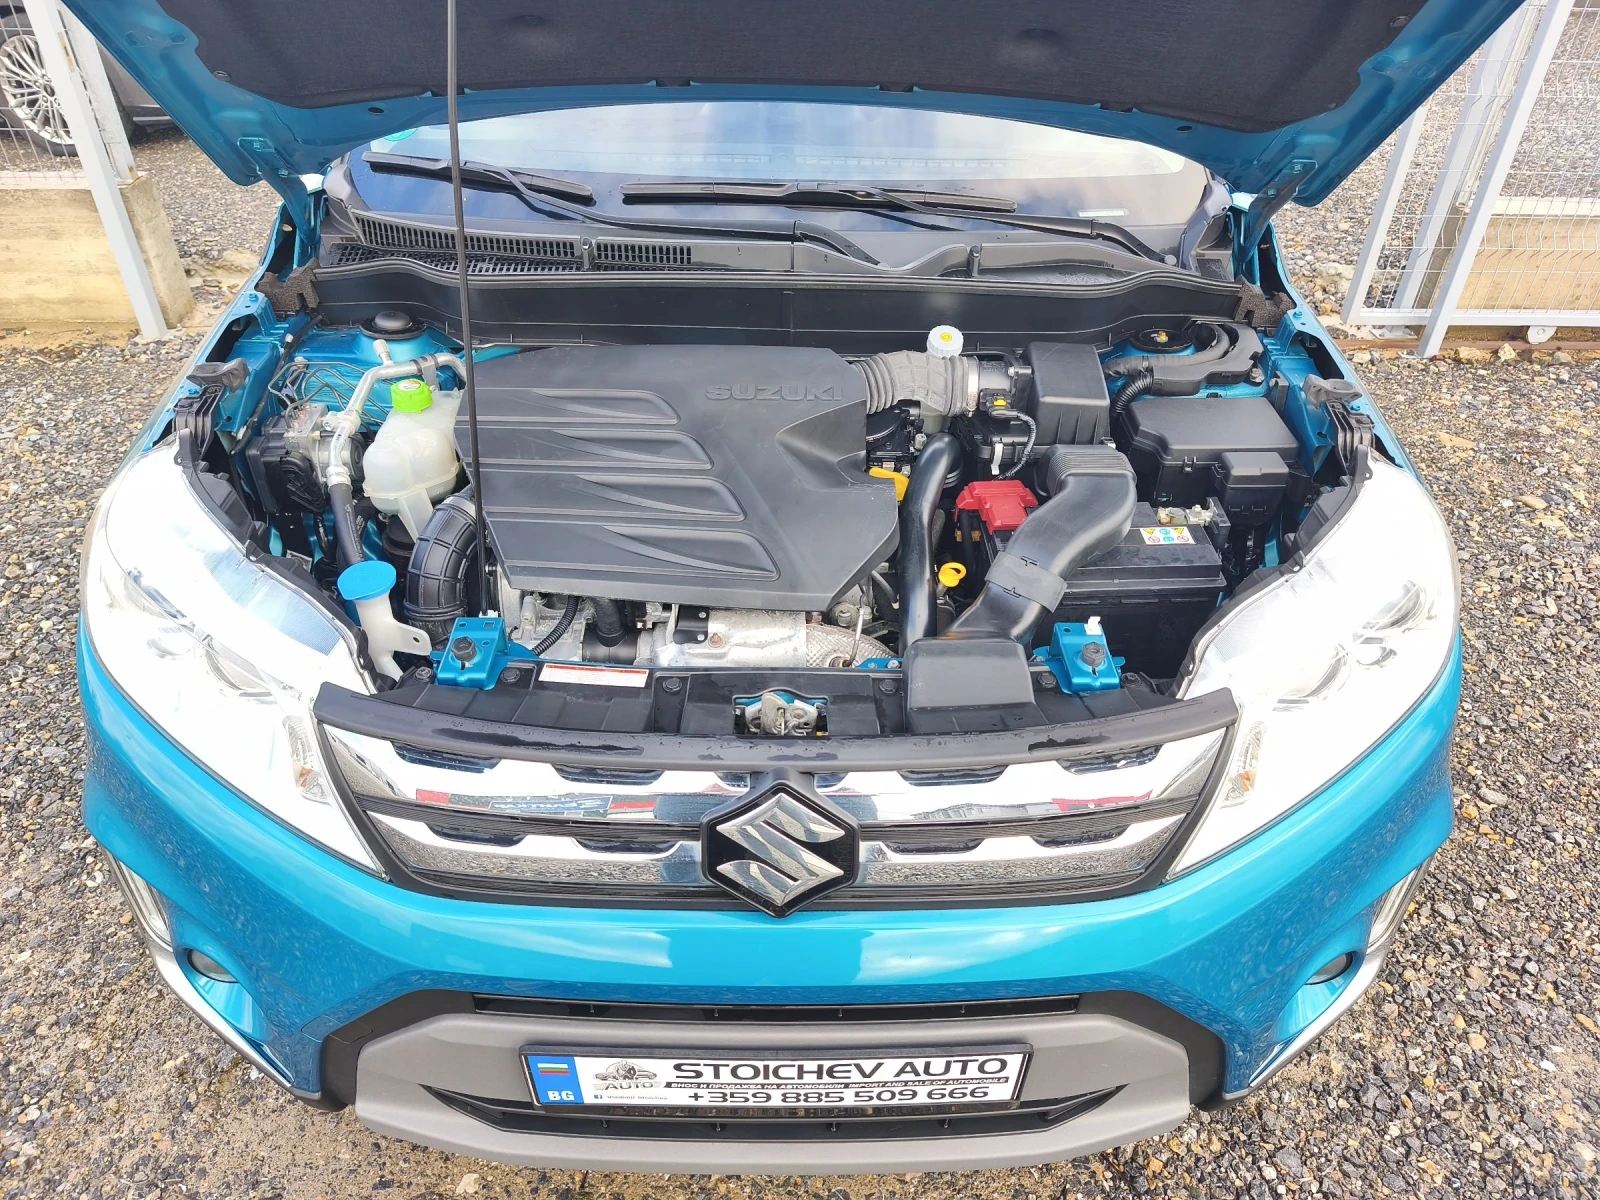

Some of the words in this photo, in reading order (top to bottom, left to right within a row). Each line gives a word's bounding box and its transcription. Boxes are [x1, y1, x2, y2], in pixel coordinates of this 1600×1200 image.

[705, 384, 842, 401] SUZUKI
[673, 1062, 885, 1081] STOICHEV
[893, 1058, 1008, 1078] AUTO
[604, 1082, 654, 1090] AUTO
[946, 1077, 1007, 1086] AUTOMOBILE
[548, 1091, 574, 1101] BG
[688, 1091, 772, 1104] +359
[780, 1091, 845, 1104] 885
[853, 1089, 918, 1103] 509
[926, 1086, 990, 1100] 666
